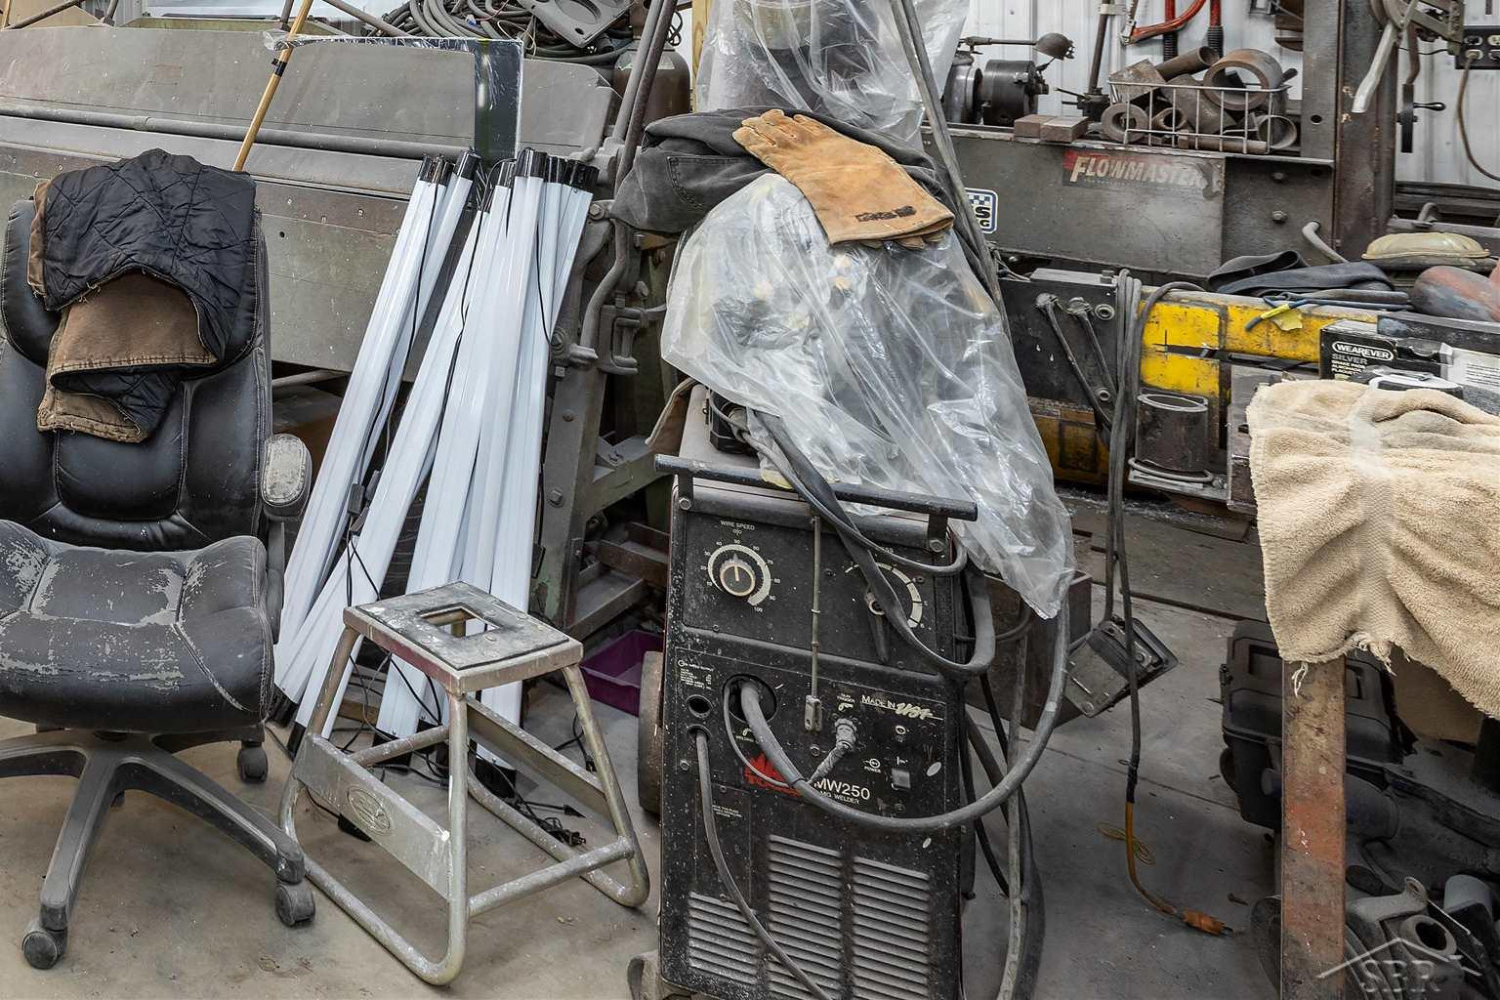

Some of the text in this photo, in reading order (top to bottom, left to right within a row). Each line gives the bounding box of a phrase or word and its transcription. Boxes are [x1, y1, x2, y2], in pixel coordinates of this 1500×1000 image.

[1336, 343, 1390, 359] WEAREVER
[1332, 353, 1368, 365] SILVER
[736, 522, 755, 530] SPEED
[862, 694, 886, 706] MADE
[887, 700, 896, 709] IN
[814, 778, 871, 800] MW250
[833, 793, 860, 804] WELDER
